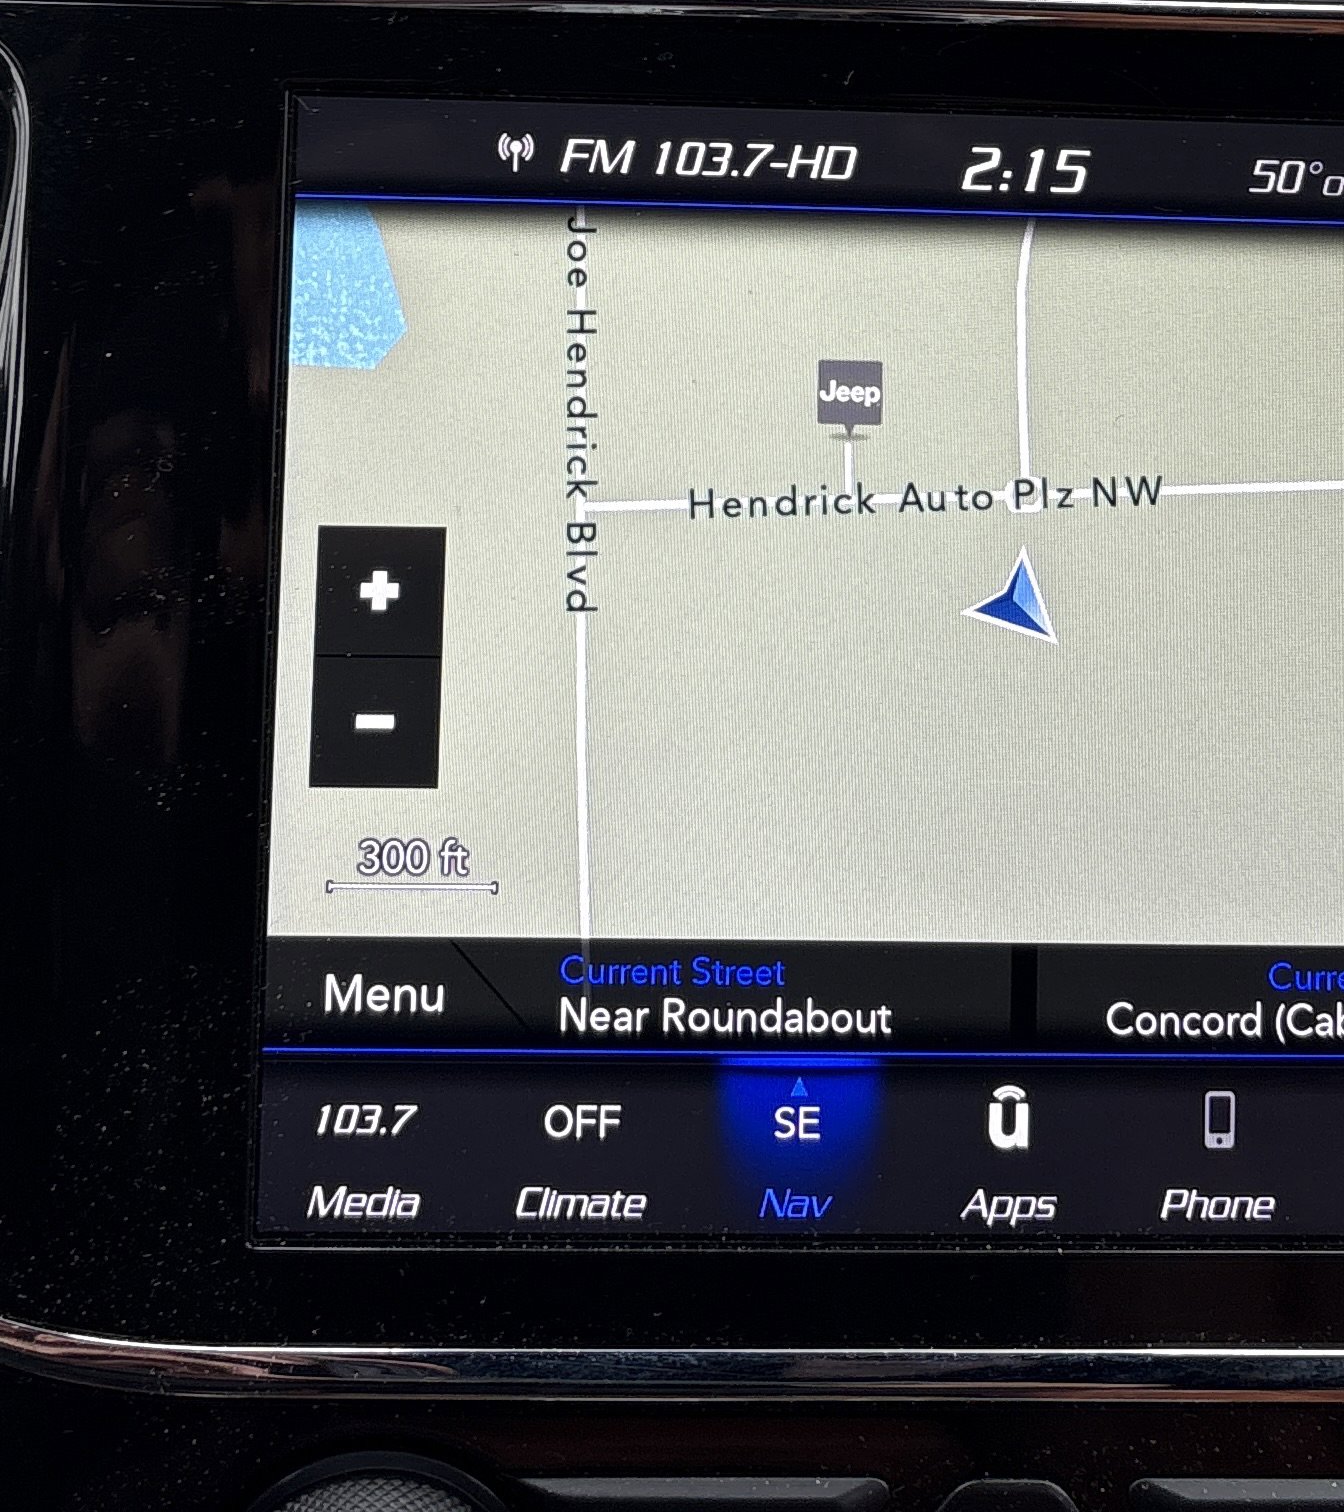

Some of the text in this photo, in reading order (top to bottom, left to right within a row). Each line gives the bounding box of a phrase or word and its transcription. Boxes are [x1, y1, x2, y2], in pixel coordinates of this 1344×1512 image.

[559, 138, 859, 181] FM 103.7-HD
[961, 146, 1091, 193] 2:15
[819, 379, 881, 407] Jeep
[566, 216, 599, 612] Joe Hendrick Blvd
[689, 474, 1164, 520] Hendrick Auto Plz NW
[356, 836, 471, 876] 300 ft
[558, 954, 786, 988] Current Street
[323, 972, 446, 1015] Menu
[558, 995, 893, 1036] Near Roundabout
[1105, 1000, 1262, 1038] Concord
[315, 1104, 419, 1137] 103.7
[543, 1104, 623, 1140] OFF
[773, 1106, 822, 1140] SE
[306, 1186, 421, 1220] Media
[514, 1186, 647, 1220] Climate
[759, 1188, 834, 1219] Nav
[959, 1188, 1058, 1229] Apps
[1159, 1189, 1276, 1222] Phone
